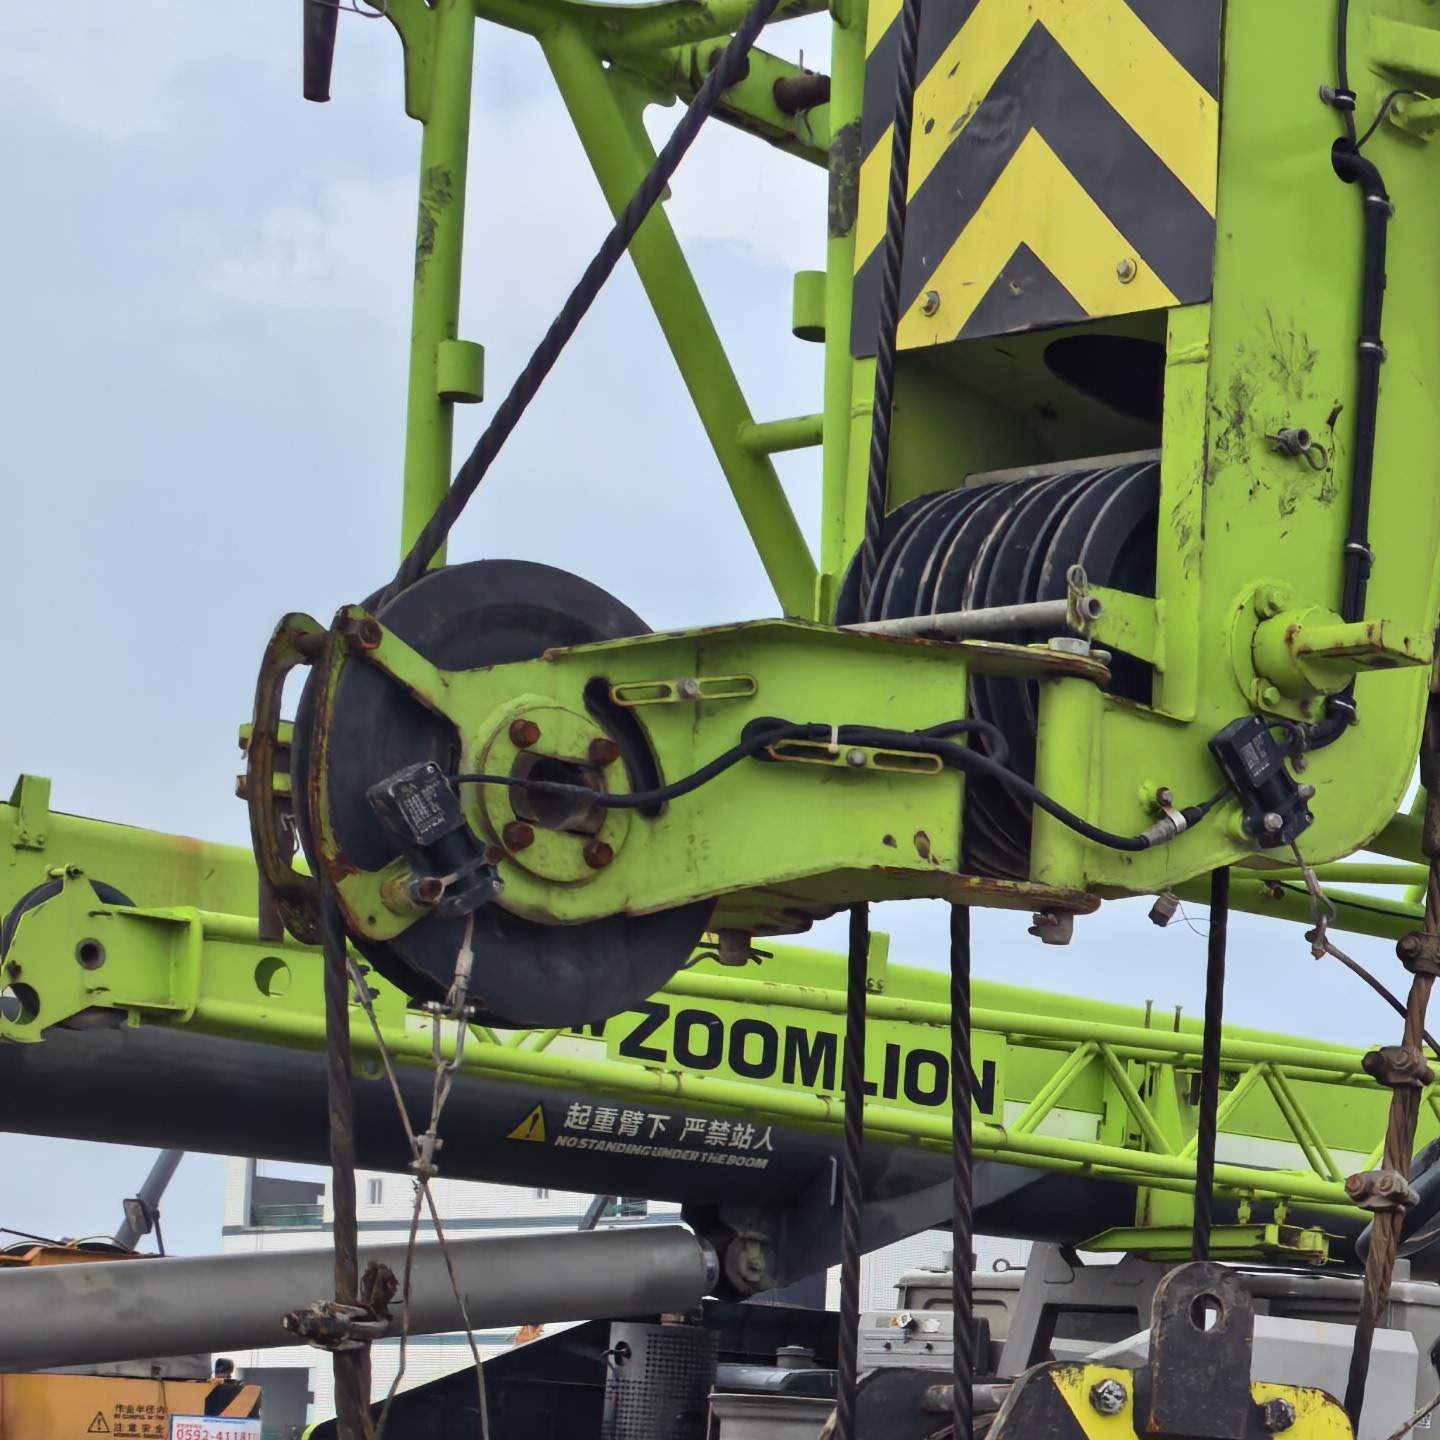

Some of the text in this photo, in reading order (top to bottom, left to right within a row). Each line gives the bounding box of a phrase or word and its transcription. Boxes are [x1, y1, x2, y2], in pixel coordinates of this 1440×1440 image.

[563, 1102, 774, 1152] 起重臂下 严禁站人
[554, 1135, 577, 1148] NO
[577, 1138, 652, 1157] STANDING
[652, 1146, 700, 1162] UNDER
[726, 1154, 769, 1169] BOOM
